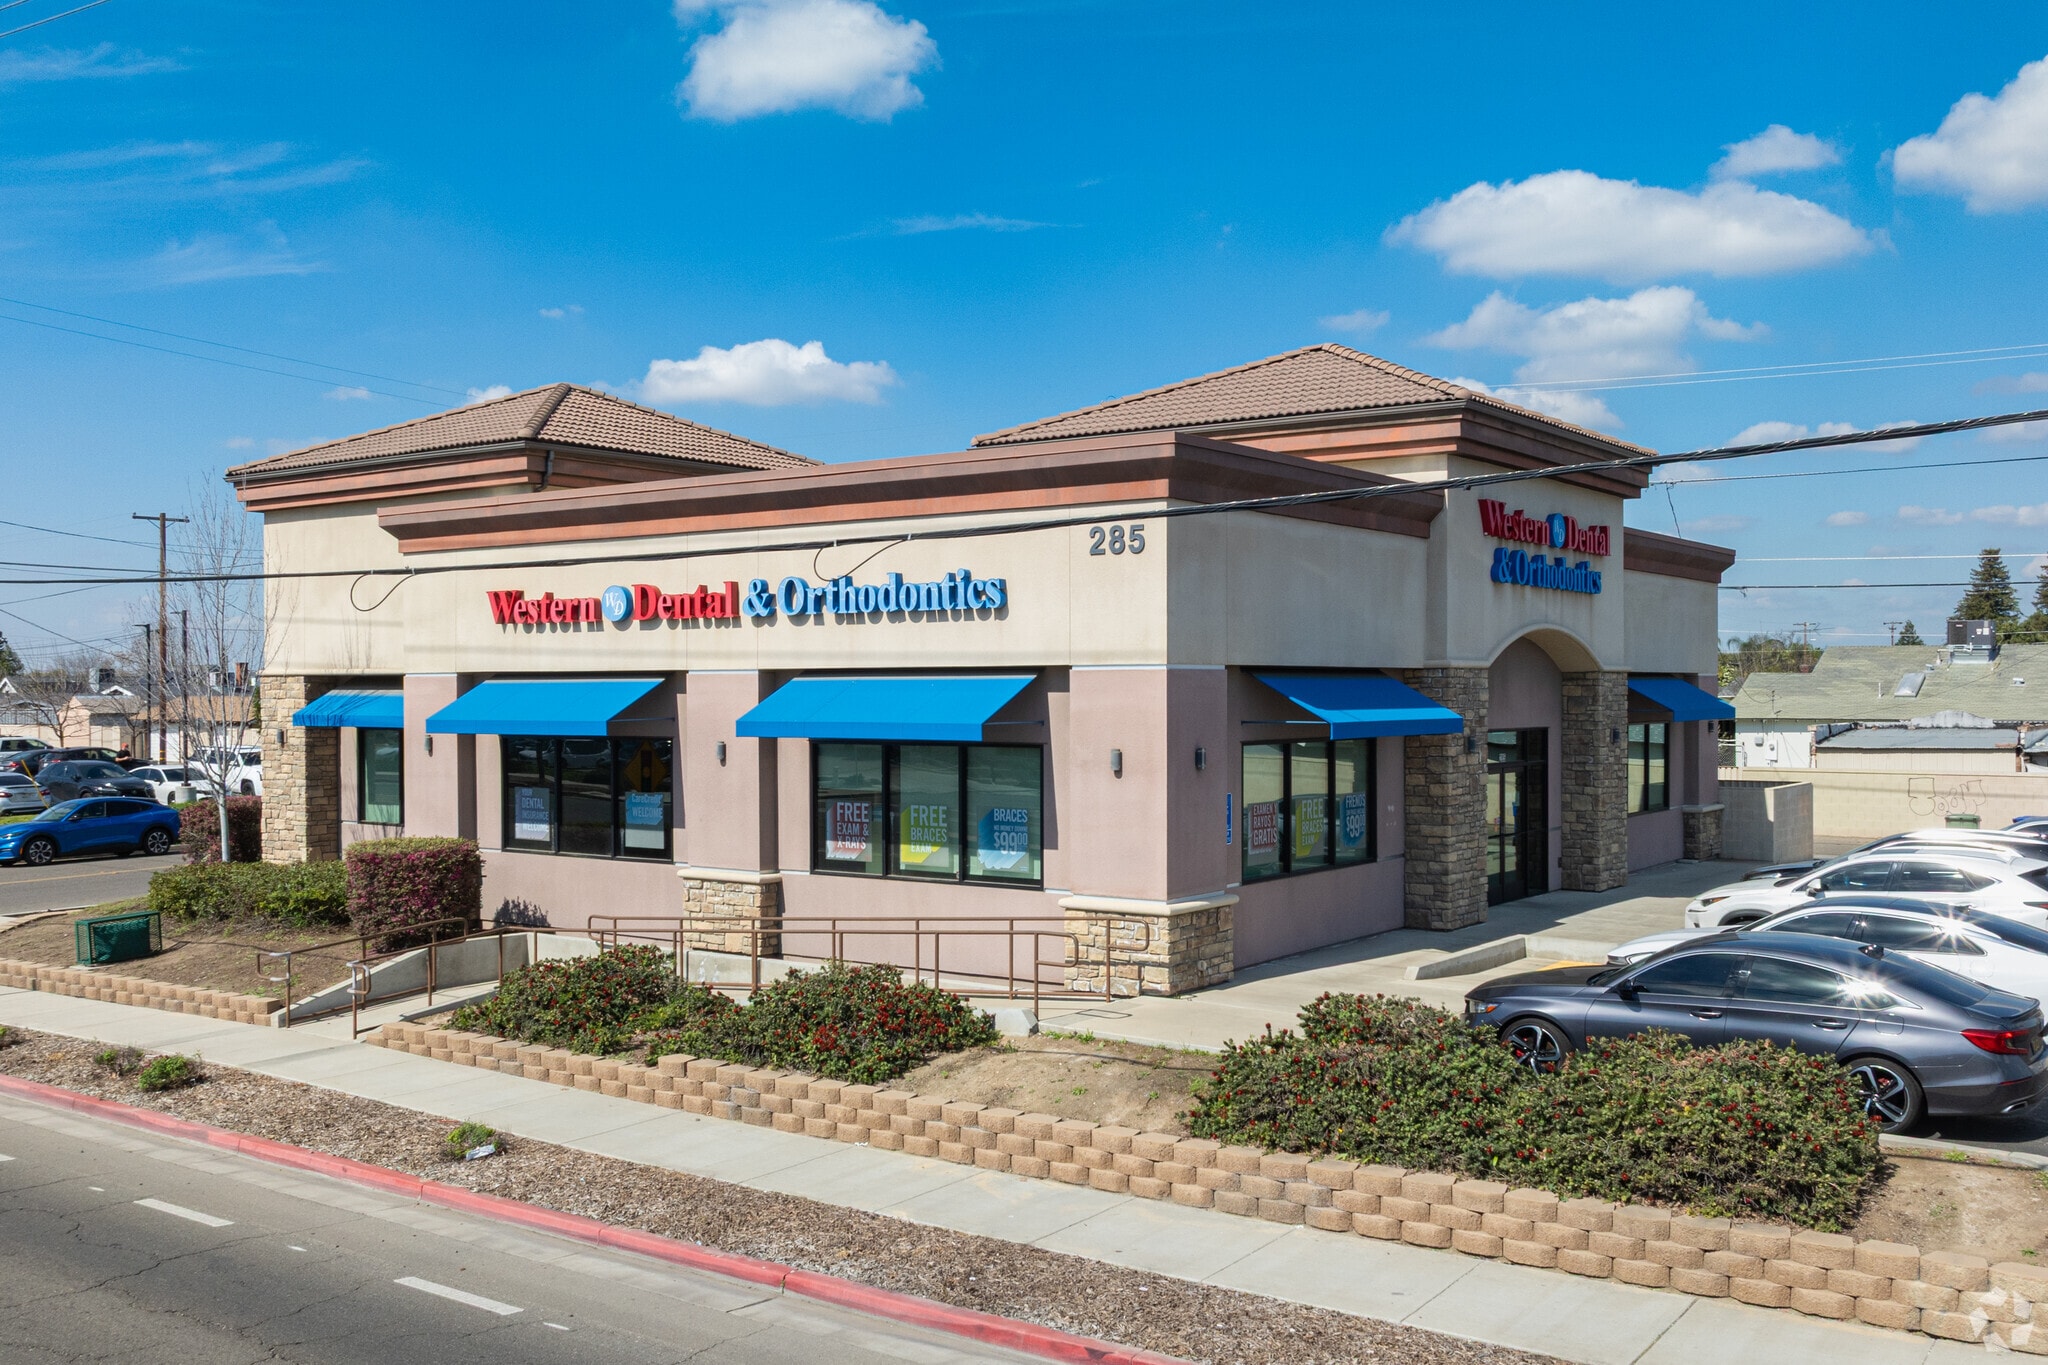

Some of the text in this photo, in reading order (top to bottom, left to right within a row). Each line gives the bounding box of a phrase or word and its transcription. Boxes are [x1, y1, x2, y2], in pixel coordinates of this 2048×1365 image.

[1478, 499, 1551, 546] Western
[1564, 515, 1611, 556] Dental
[1089, 524, 1145, 556] 285
[1491, 547, 1602, 594] & Orthodontics
[486, 589, 602, 625] Western
[631, 581, 740, 621] Dental
[742, 578, 777, 617] &
[777, 568, 1006, 616] Orthodontics
[522, 797, 544, 809] DENTAL
[1302, 798, 1324, 819] FREE
[632, 806, 663, 818] WELCOME
[837, 802, 869, 822] FREE
[911, 804, 947, 827] FREE
[993, 808, 1028, 823] BRACES
[523, 820, 549, 832] WELCOME
[1253, 814, 1271, 828] RAYOS
[1302, 818, 1324, 834] BRACES
[837, 822, 869, 836] EXAM &
[911, 827, 947, 842] BRACES
[837, 836, 866, 849] X-RAYS
[1253, 828, 1278, 846] GRATIS
[911, 841, 931, 854] EXAM
